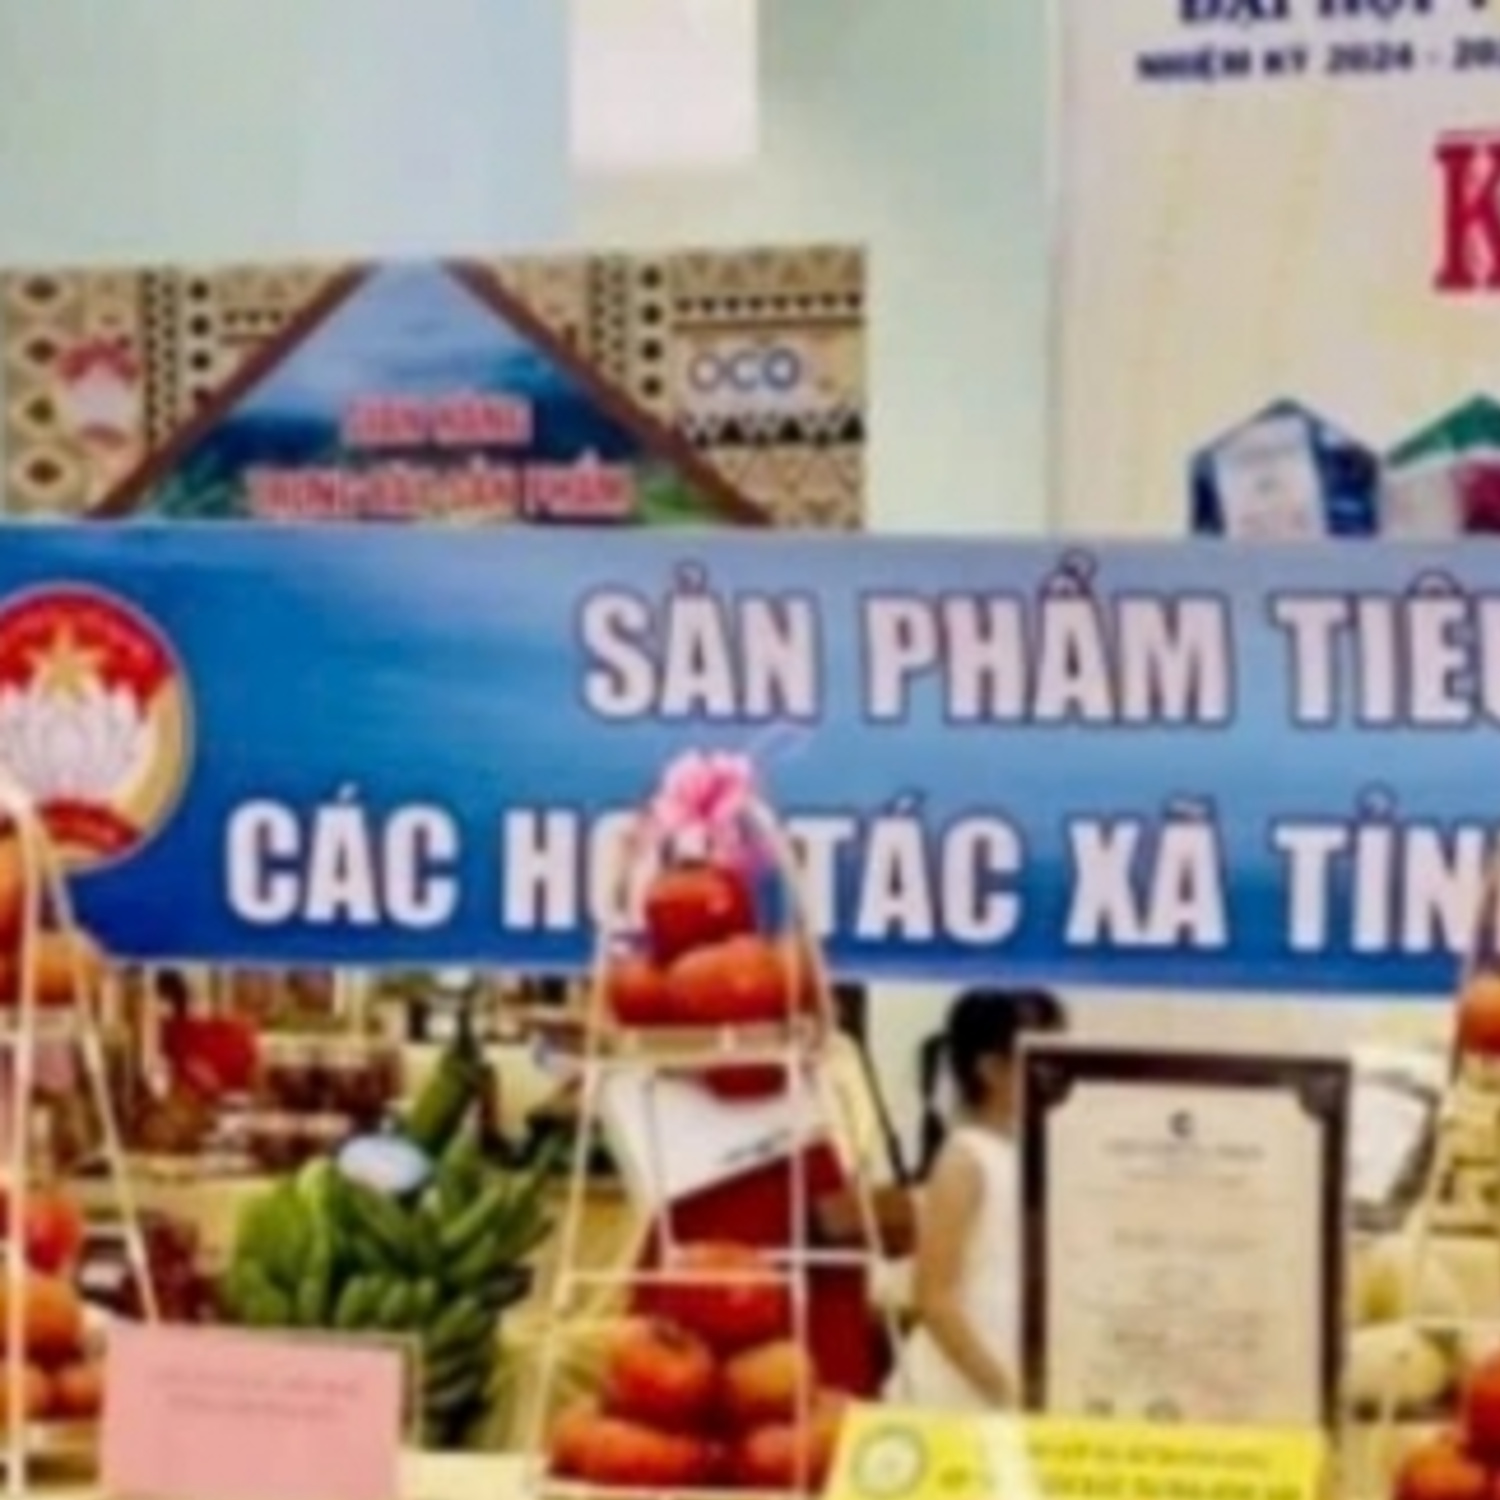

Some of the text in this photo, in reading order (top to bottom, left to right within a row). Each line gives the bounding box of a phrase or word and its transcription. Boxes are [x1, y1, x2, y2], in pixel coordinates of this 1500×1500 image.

[1326, 41, 1413, 75] 2024
[580, 562, 818, 722] SẢN
[865, 551, 1232, 723] PHẨM
[224, 784, 462, 925] CÁC
[787, 791, 1022, 943] TÁC
[1063, 795, 1229, 949] XÃ
